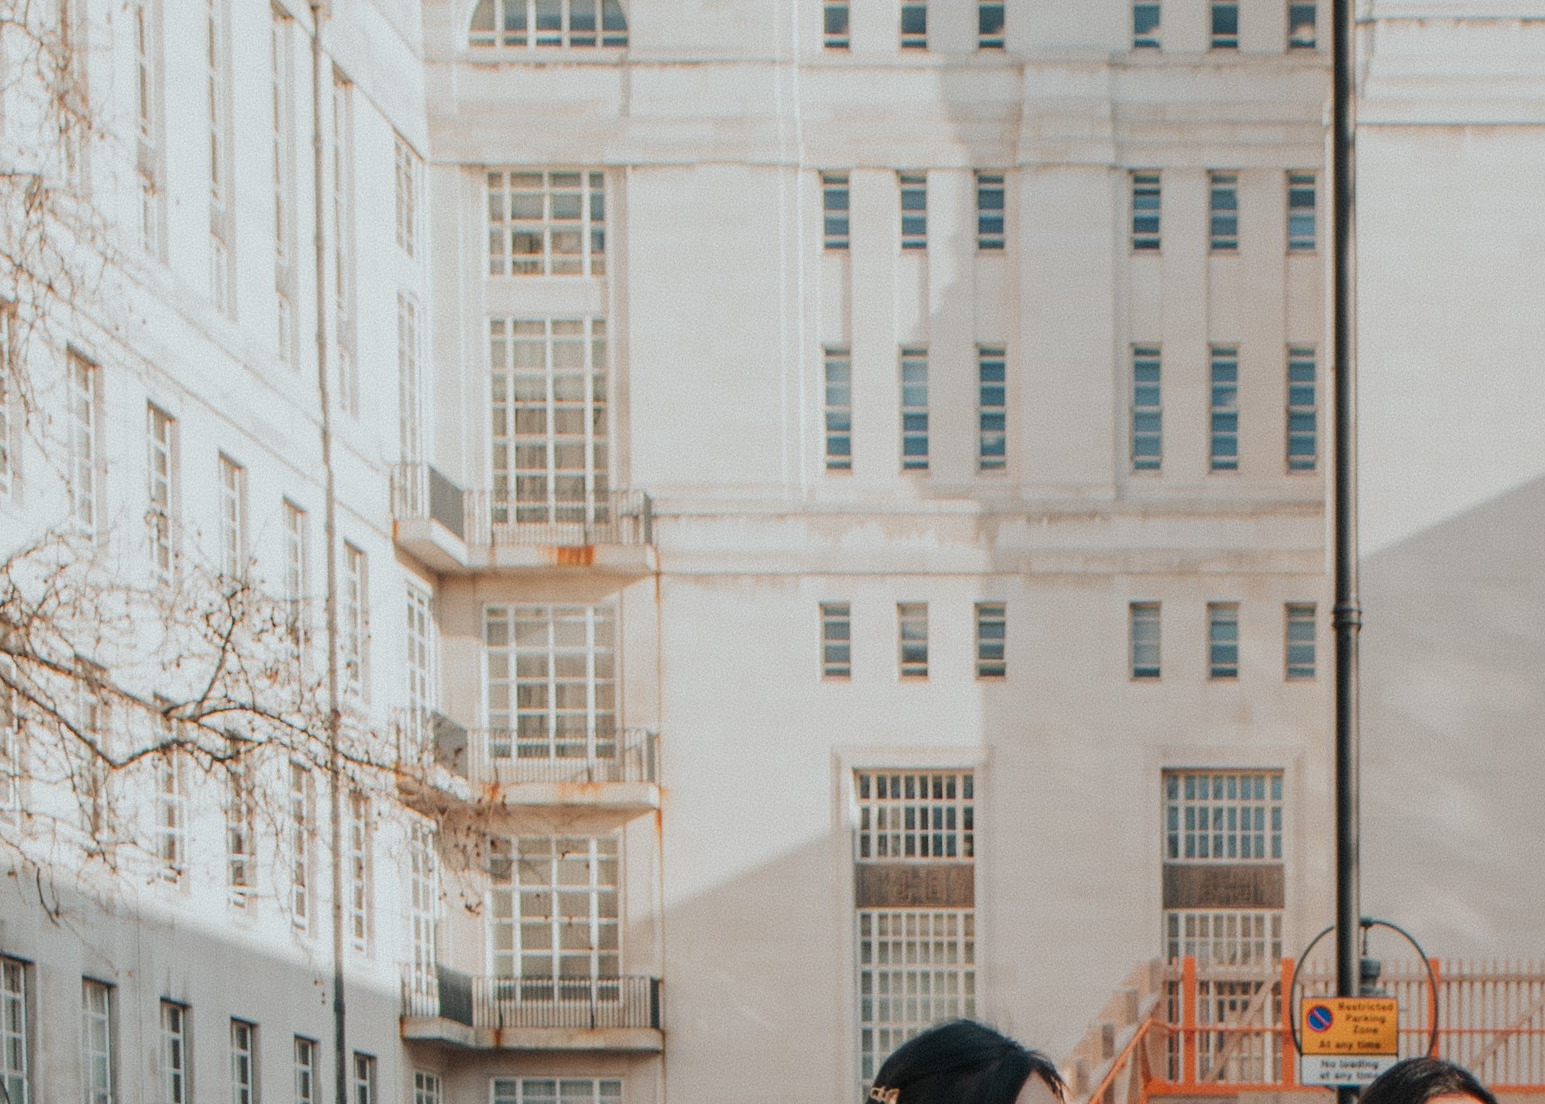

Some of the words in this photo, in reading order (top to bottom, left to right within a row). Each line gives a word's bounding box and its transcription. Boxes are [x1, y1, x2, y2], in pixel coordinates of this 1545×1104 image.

[1338, 1002, 1393, 1011] Restricted
[1345, 1014, 1386, 1024] Parking
[1353, 1025, 1378, 1034] Zone
[1319, 1040, 1331, 1048] At
[1335, 1042, 1353, 1050] any
[1357, 1041, 1381, 1049] time
[1321, 1060, 1336, 1068] No
[1339, 1060, 1379, 1070] loading
[1320, 1071, 1330, 1079] at
[1335, 1073, 1352, 1081] any
